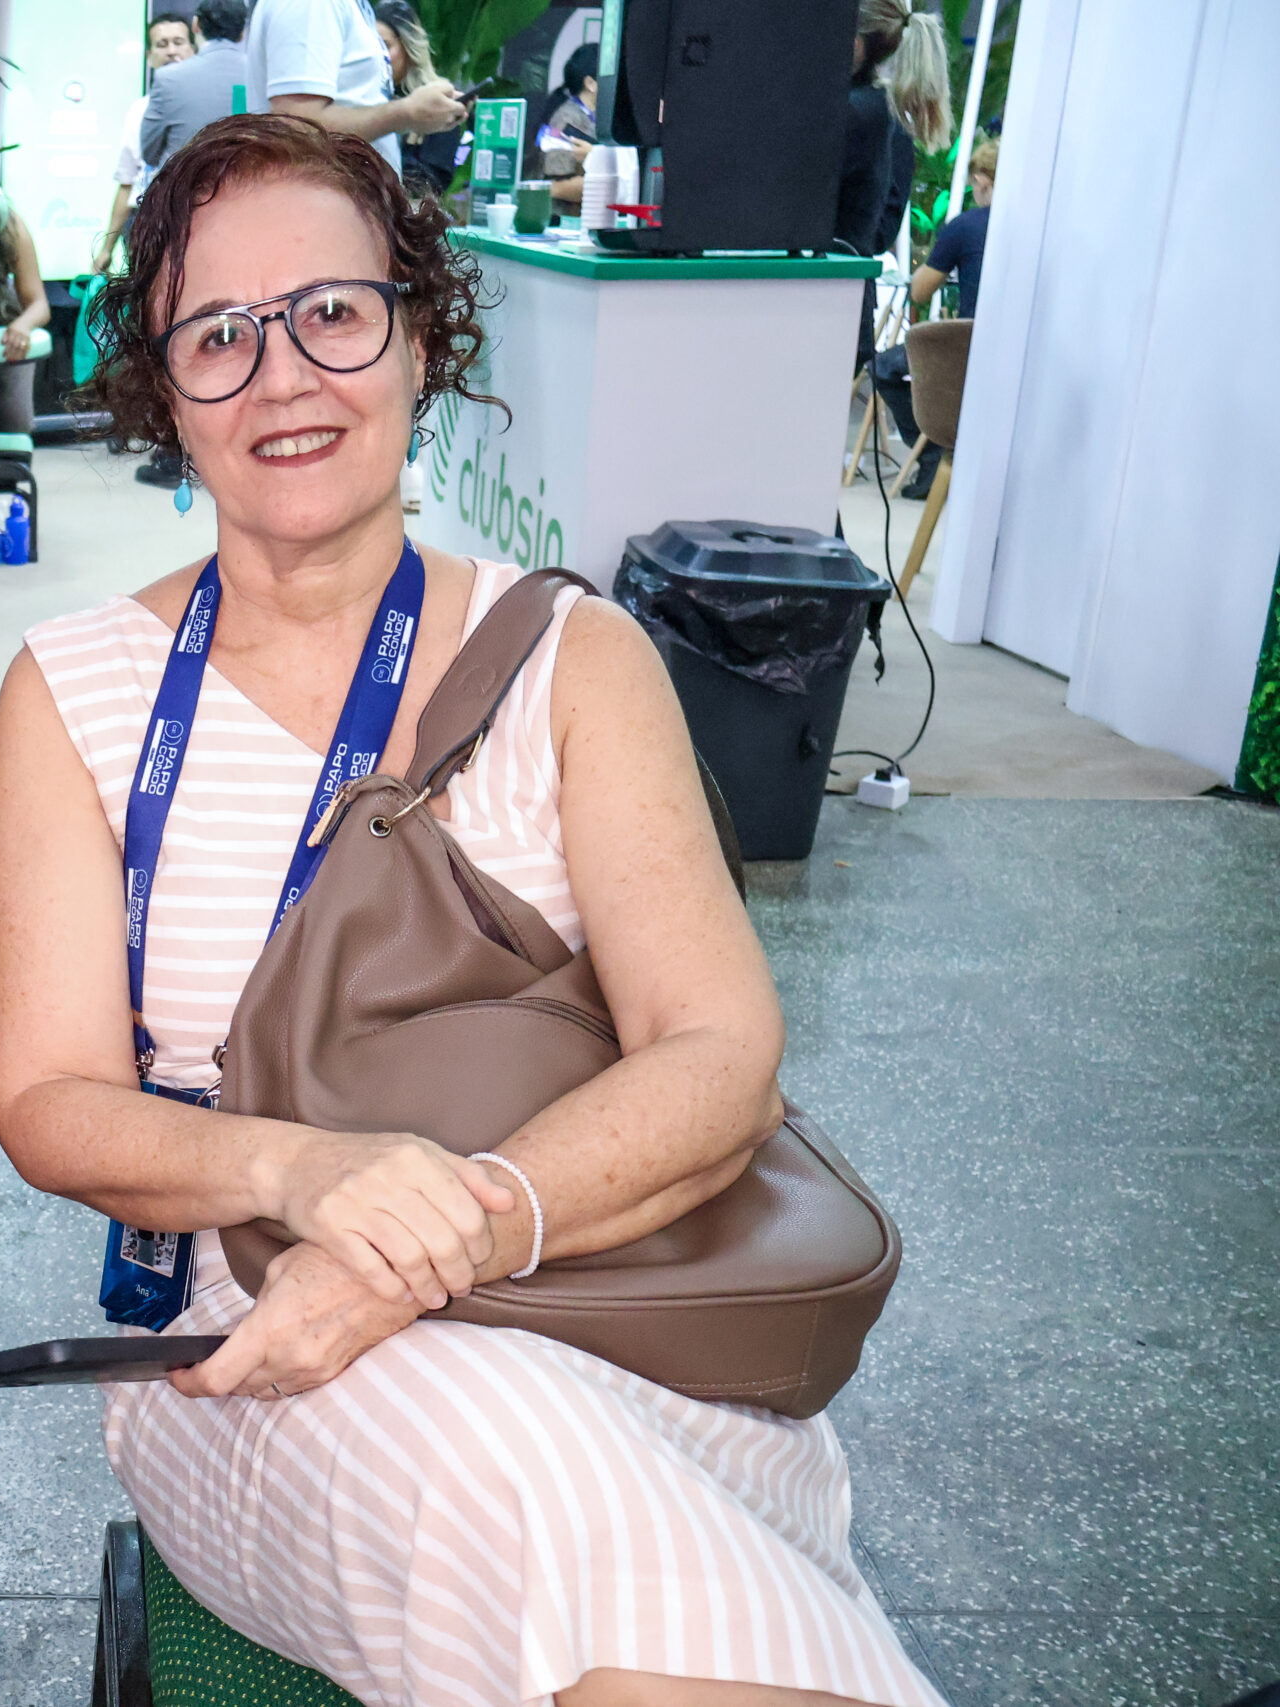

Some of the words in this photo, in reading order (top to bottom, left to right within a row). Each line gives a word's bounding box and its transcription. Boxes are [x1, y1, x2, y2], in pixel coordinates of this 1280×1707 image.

[186, 610, 203, 653] CONDO
[194, 609, 210, 653] PAPO
[378, 609, 397, 657] PAPO
[388, 613, 406, 658] CONDO
[148, 745, 167, 794] CONDO
[155, 747, 178, 796] PAPO
[323, 742, 348, 792] PAPO
[128, 896, 138, 947] CONDO
[133, 897, 144, 949] PAPO
[135, 1284, 150, 1297] Ana
